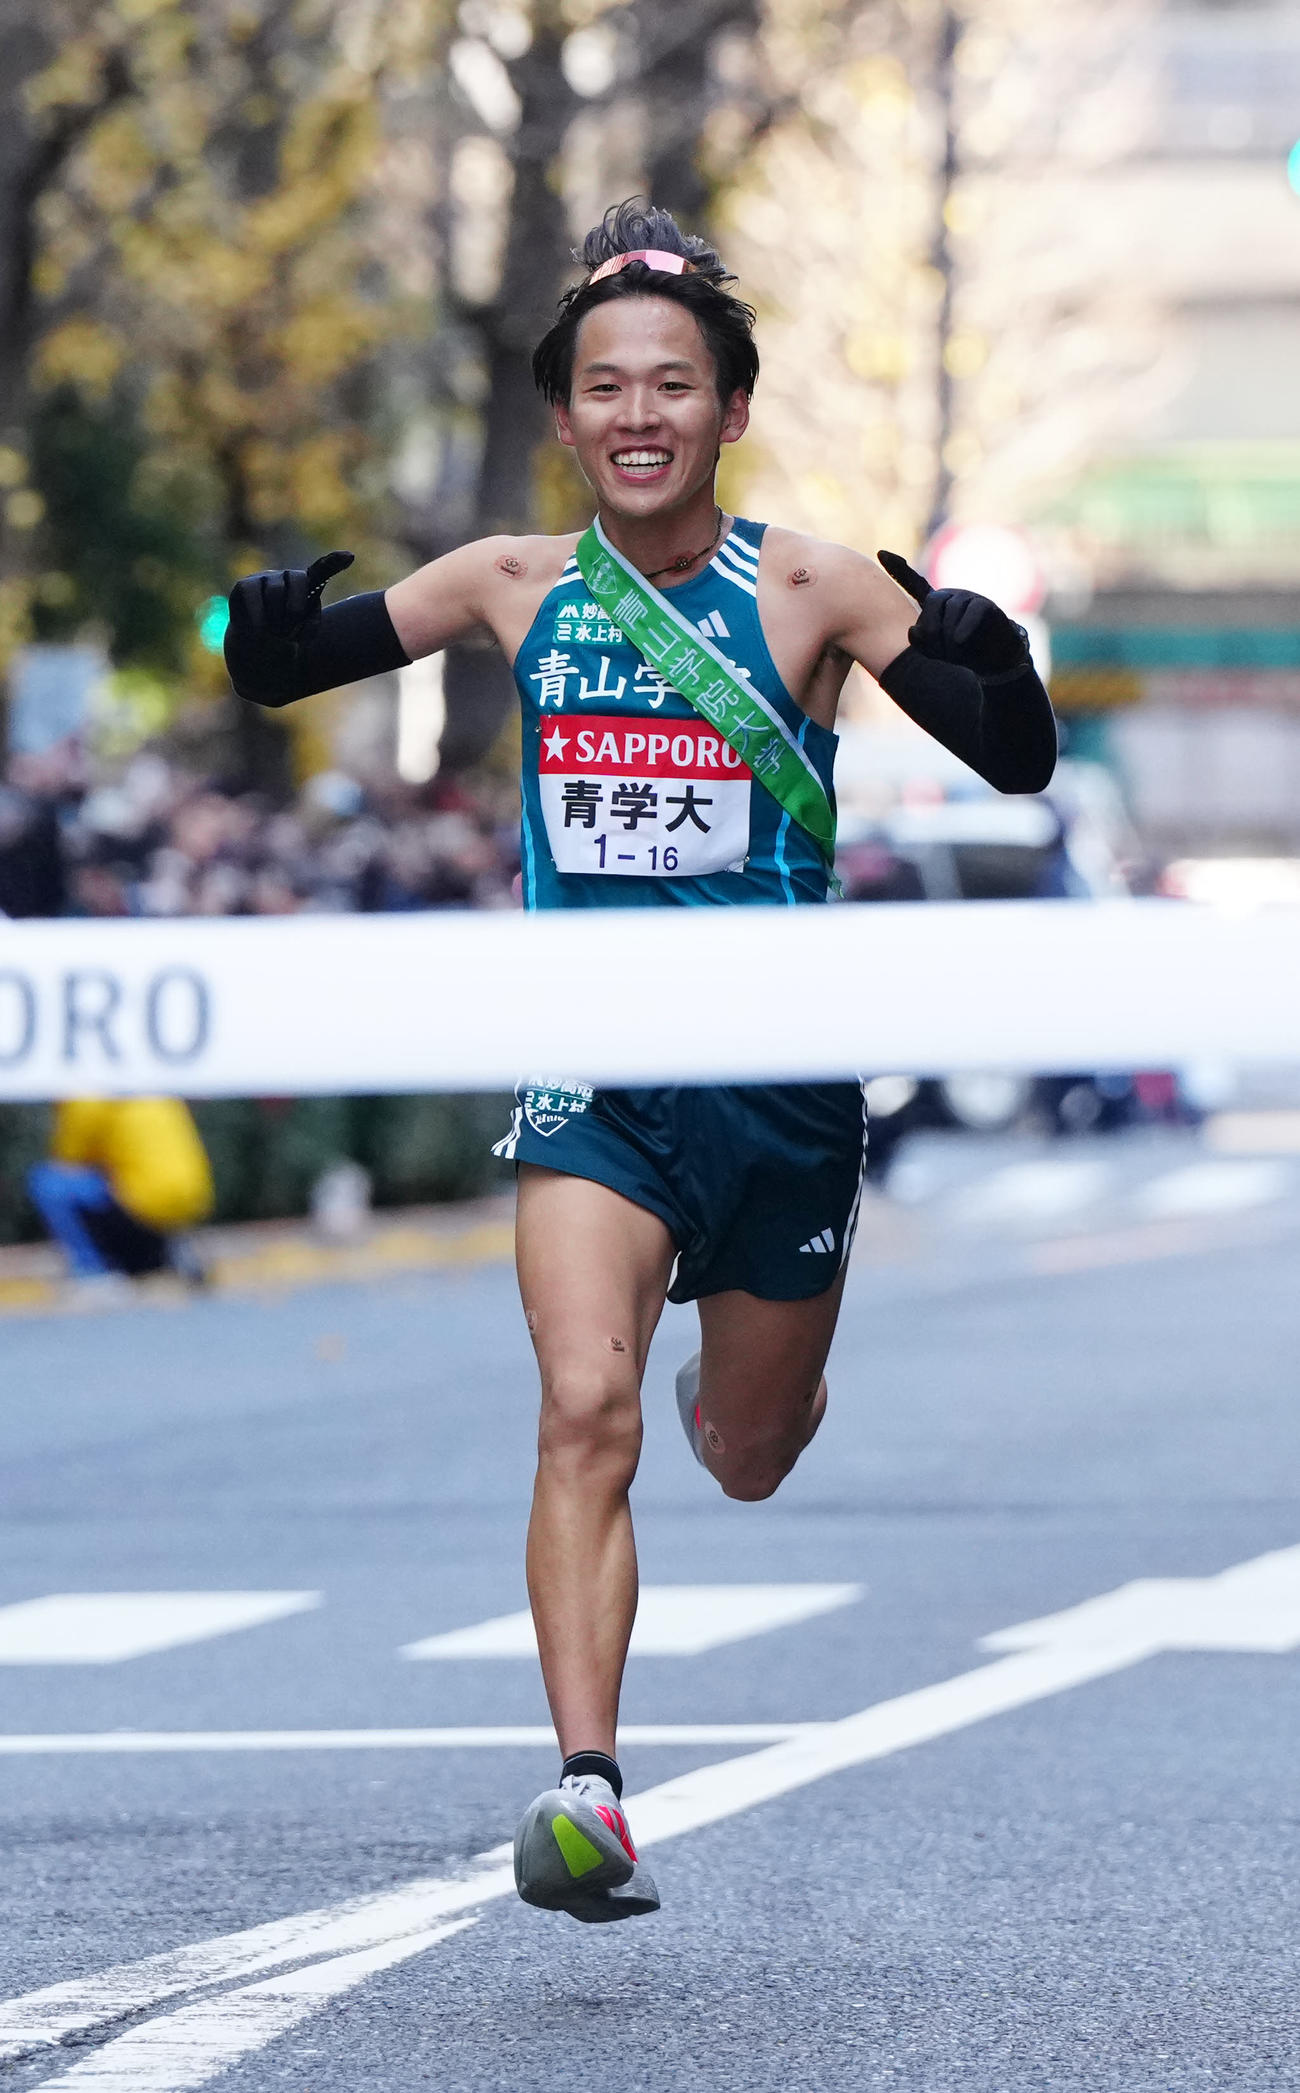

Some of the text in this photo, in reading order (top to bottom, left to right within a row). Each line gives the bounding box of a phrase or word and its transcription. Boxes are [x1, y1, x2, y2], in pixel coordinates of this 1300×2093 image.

[575, 623, 623, 642] 水上村
[576, 730, 741, 769] SAPPORO
[561, 780, 713, 834] 青学大
